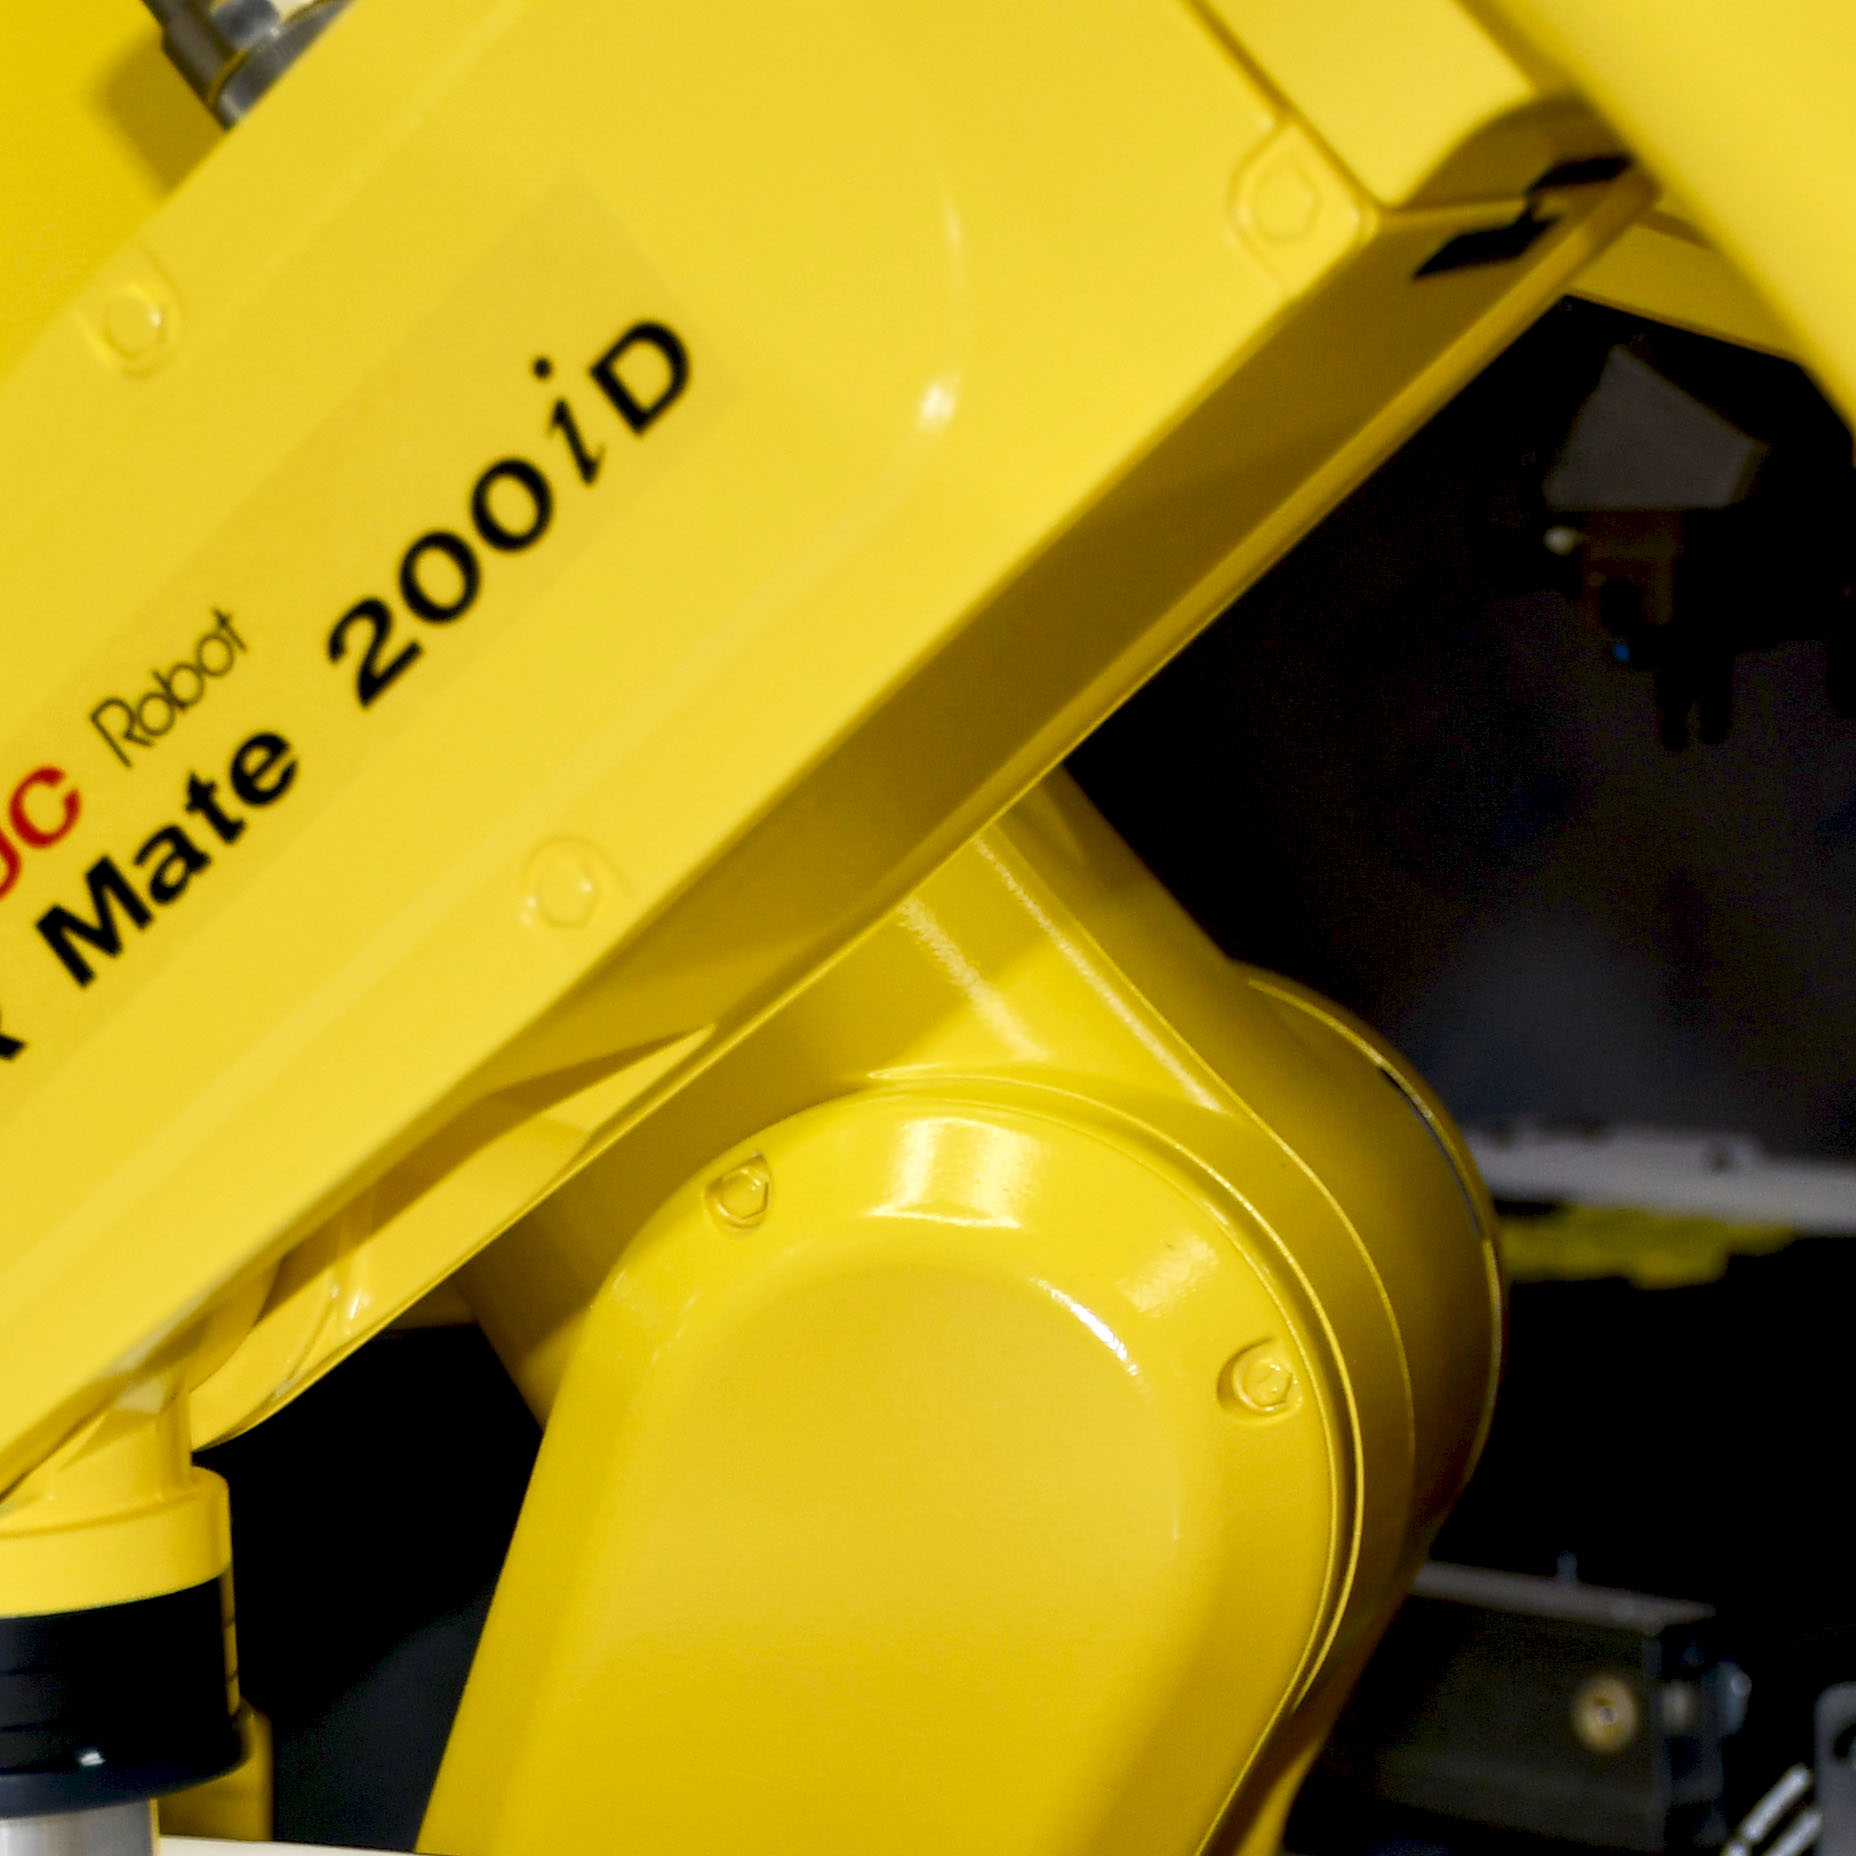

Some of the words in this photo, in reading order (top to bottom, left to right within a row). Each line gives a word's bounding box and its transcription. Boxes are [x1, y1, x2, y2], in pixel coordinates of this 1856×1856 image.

[34, 731, 299, 989] Mate
[326, 320, 692, 709] 200iD
[89, 607, 249, 768] Robot
